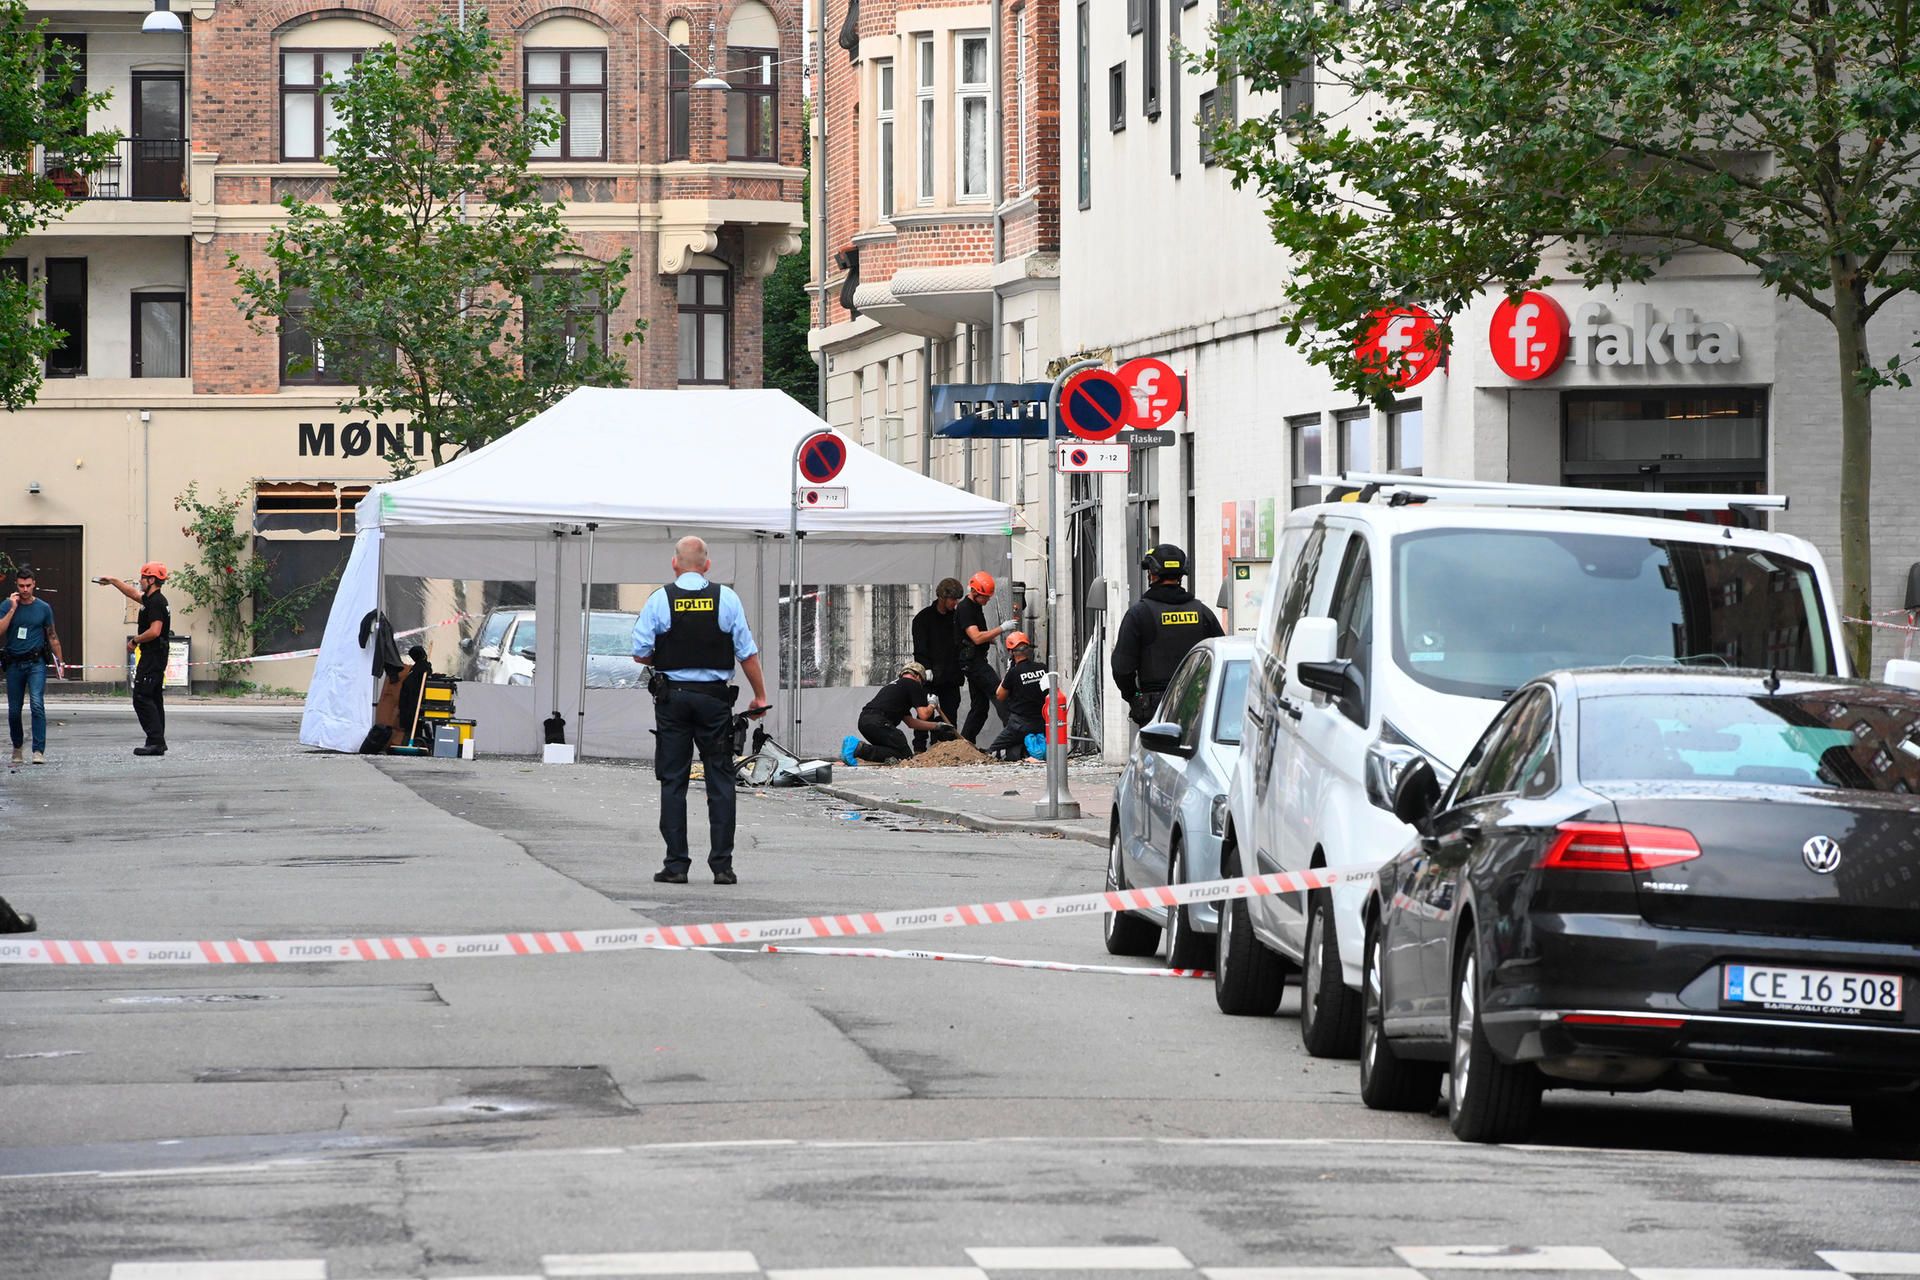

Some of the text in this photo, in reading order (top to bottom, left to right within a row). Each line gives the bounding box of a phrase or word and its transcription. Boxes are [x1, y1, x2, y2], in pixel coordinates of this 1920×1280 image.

[1568, 302, 1742, 366] fakta
[298, 420, 427, 458] MØNT
[1129, 434, 1163, 444] Flasker
[675, 600, 713, 610] POLITI
[1162, 613, 1198, 623] POLITI
[1750, 972, 1896, 1007] CE 16 508
